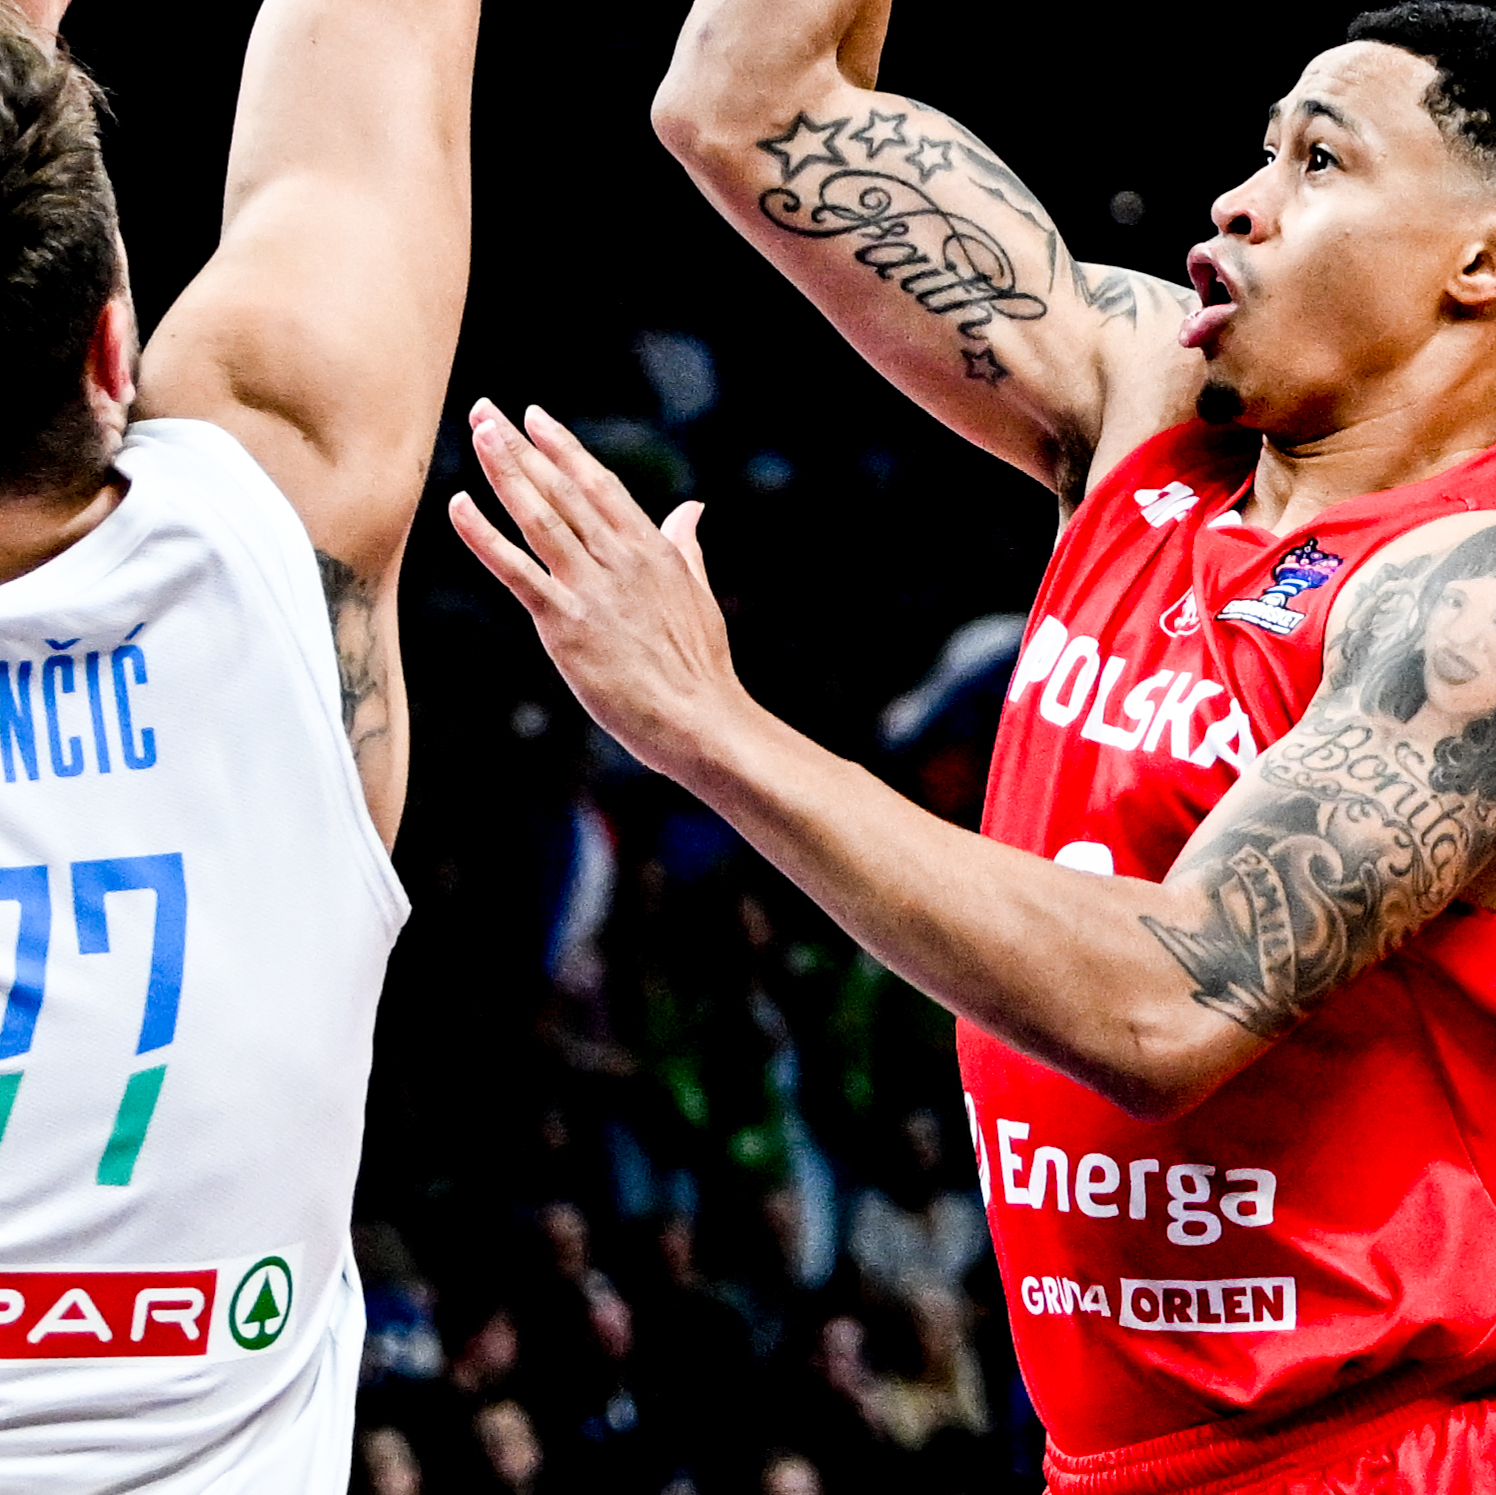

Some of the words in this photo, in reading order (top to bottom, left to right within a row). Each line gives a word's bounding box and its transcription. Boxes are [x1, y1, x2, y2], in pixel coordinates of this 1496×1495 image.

[1007, 614, 1258, 772] POLSKA
[996, 1117, 1277, 1246] Energa
[1129, 1284, 1285, 1324] ORLEN
